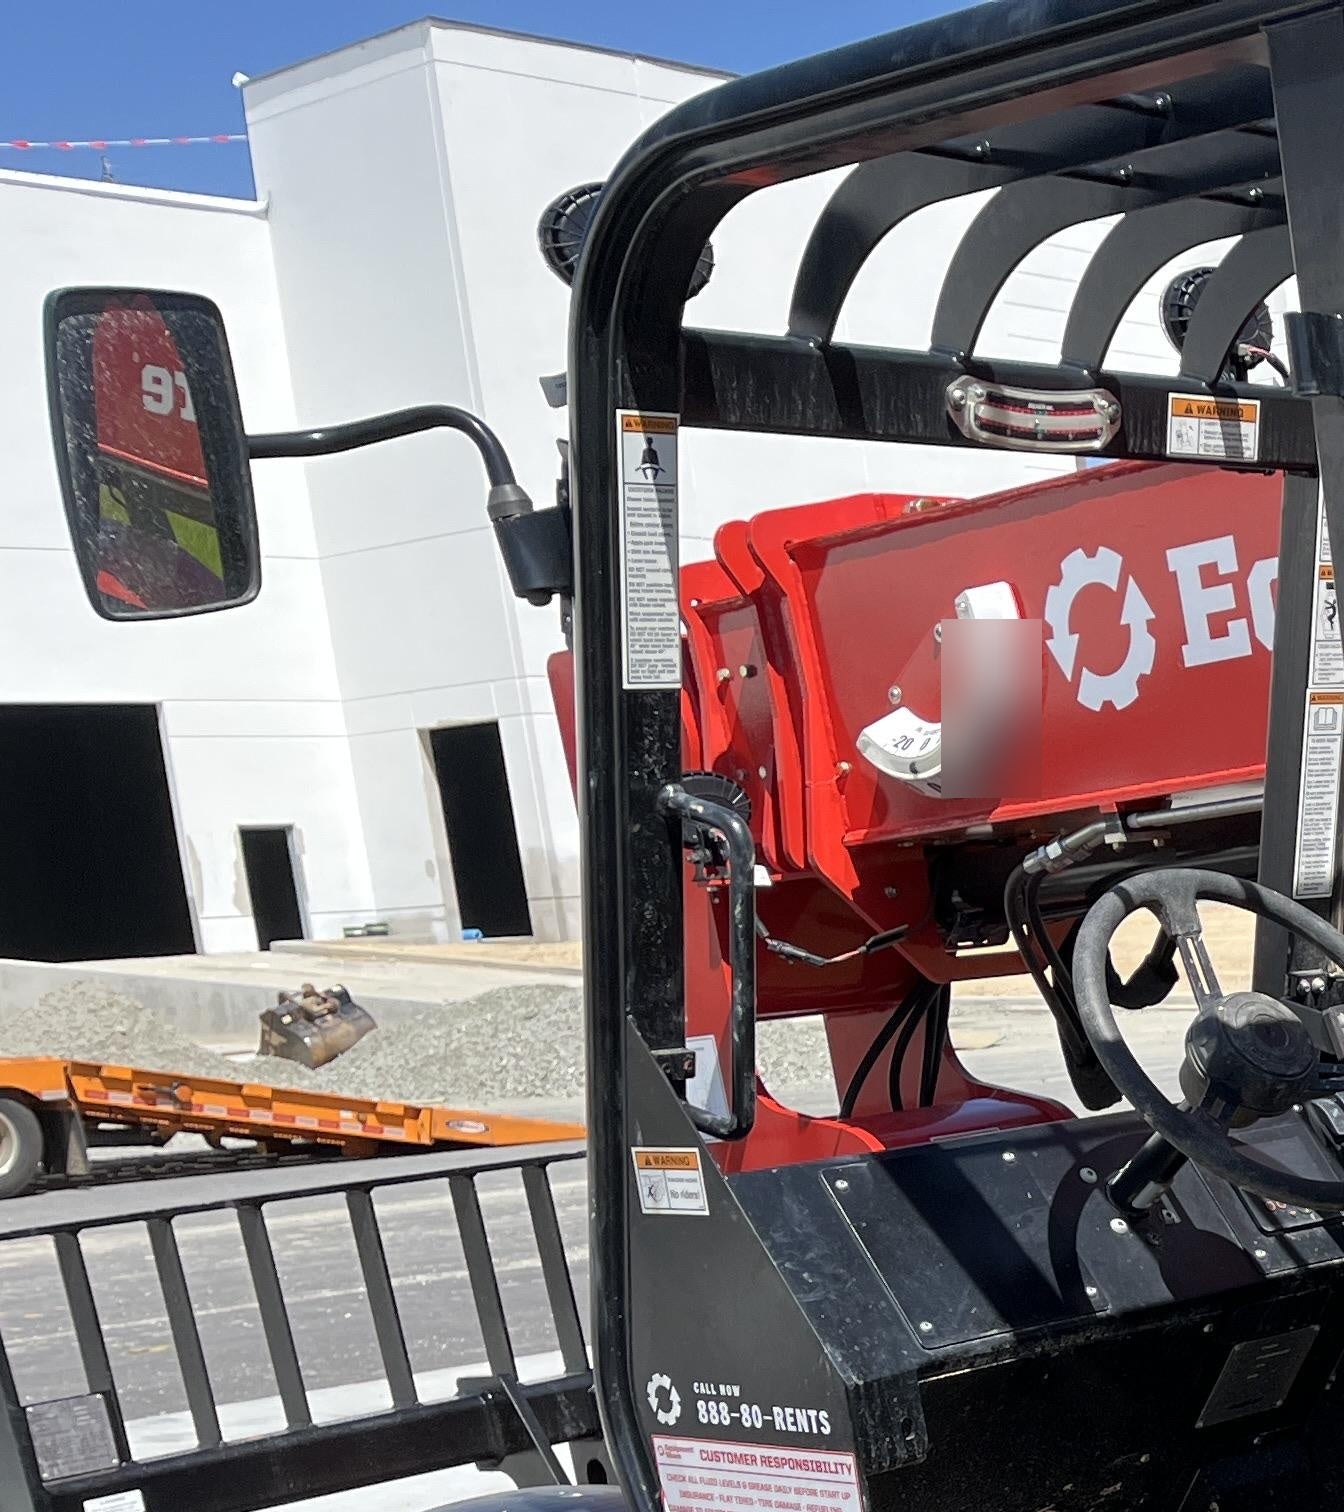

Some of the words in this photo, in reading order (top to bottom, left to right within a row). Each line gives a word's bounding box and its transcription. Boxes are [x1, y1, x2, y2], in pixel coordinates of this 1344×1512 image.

[1197, 404, 1244, 418] WARNING
[653, 1155, 690, 1166] WARNING
[693, 1381, 717, 1395] CALL
[719, 1383, 741, 1397] NOW
[696, 1399, 832, 1436] 888-80-RENTS
[699, 1449, 758, 1467] CUSTOMER
[759, 1455, 852, 1476] RESPONSIBILITY
[666, 1473, 687, 1483] CHECK
[688, 1474, 699, 1484] ALL
[841, 1491, 851, 1501] UP
